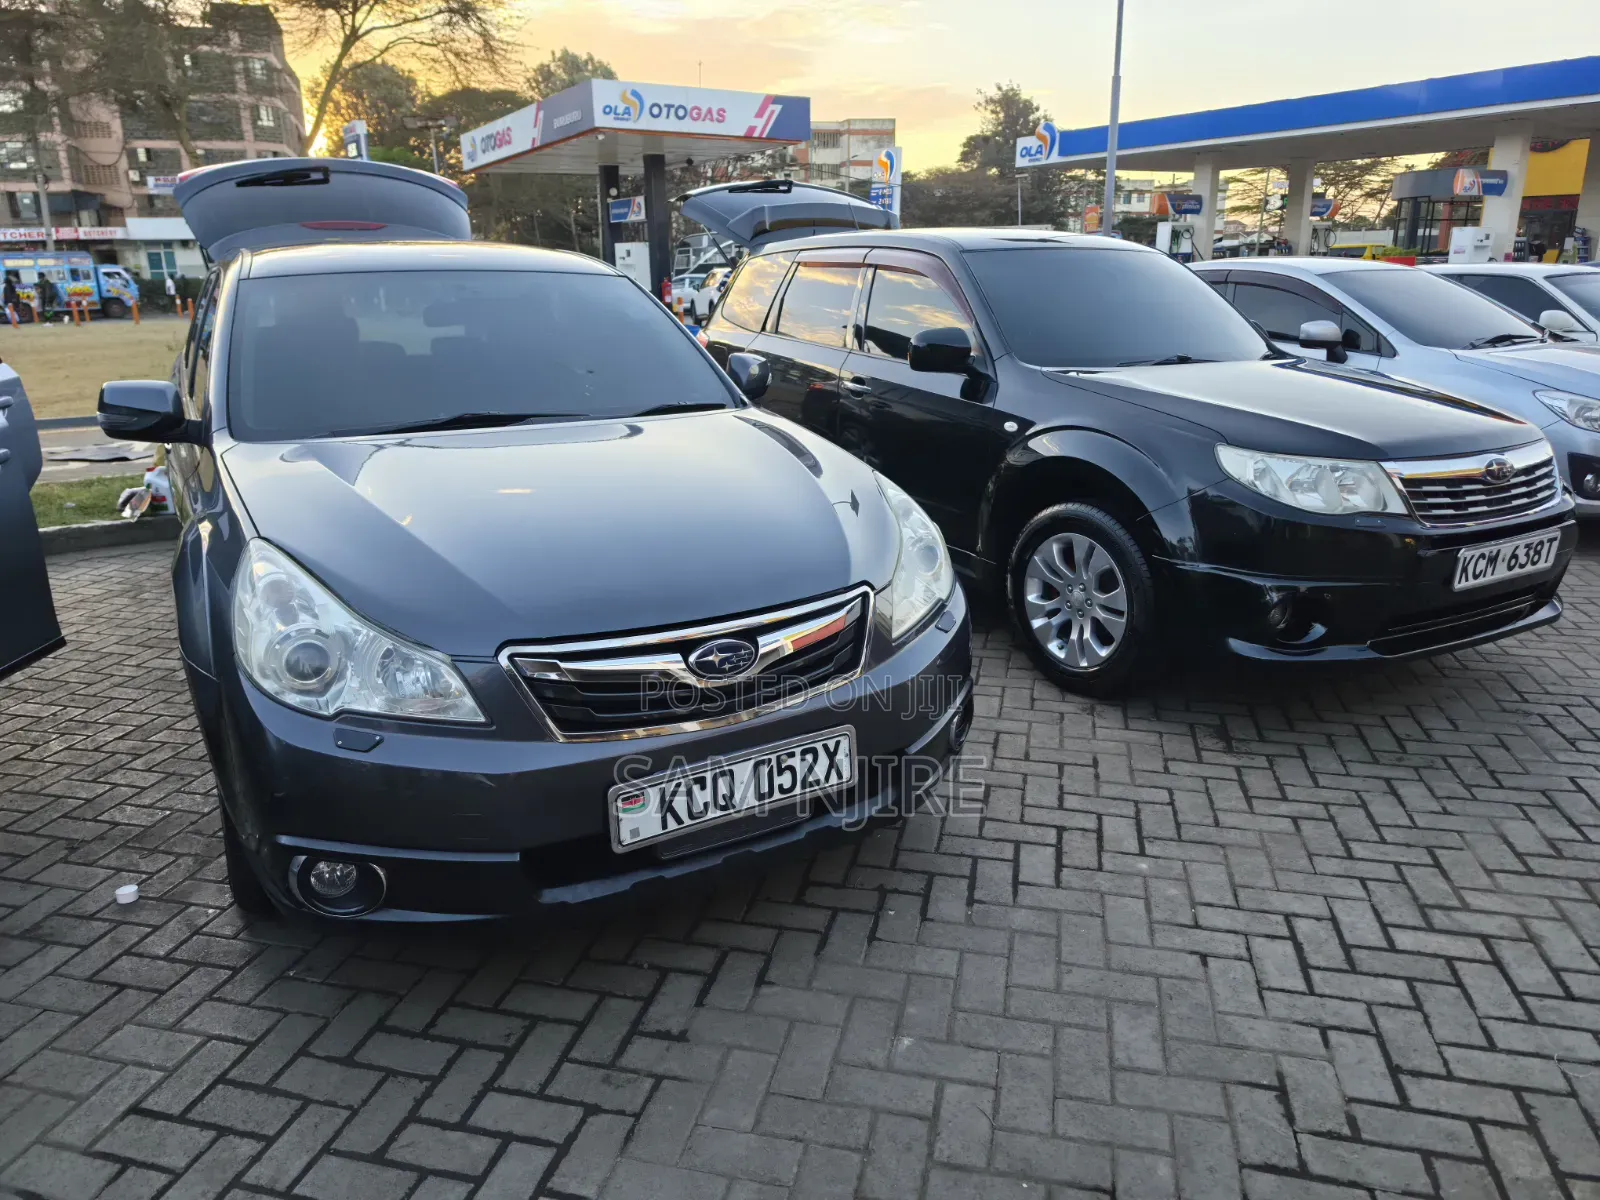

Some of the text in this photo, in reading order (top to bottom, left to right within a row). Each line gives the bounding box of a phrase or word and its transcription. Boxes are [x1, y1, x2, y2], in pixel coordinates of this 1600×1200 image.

[602, 102, 726, 123] OLA OTOGAS
[480, 126, 513, 154] OTOGAS
[1020, 144, 1043, 158] OLA
[1457, 537, 1558, 585] KCM 638T
[659, 739, 844, 831] KCQ 052X
